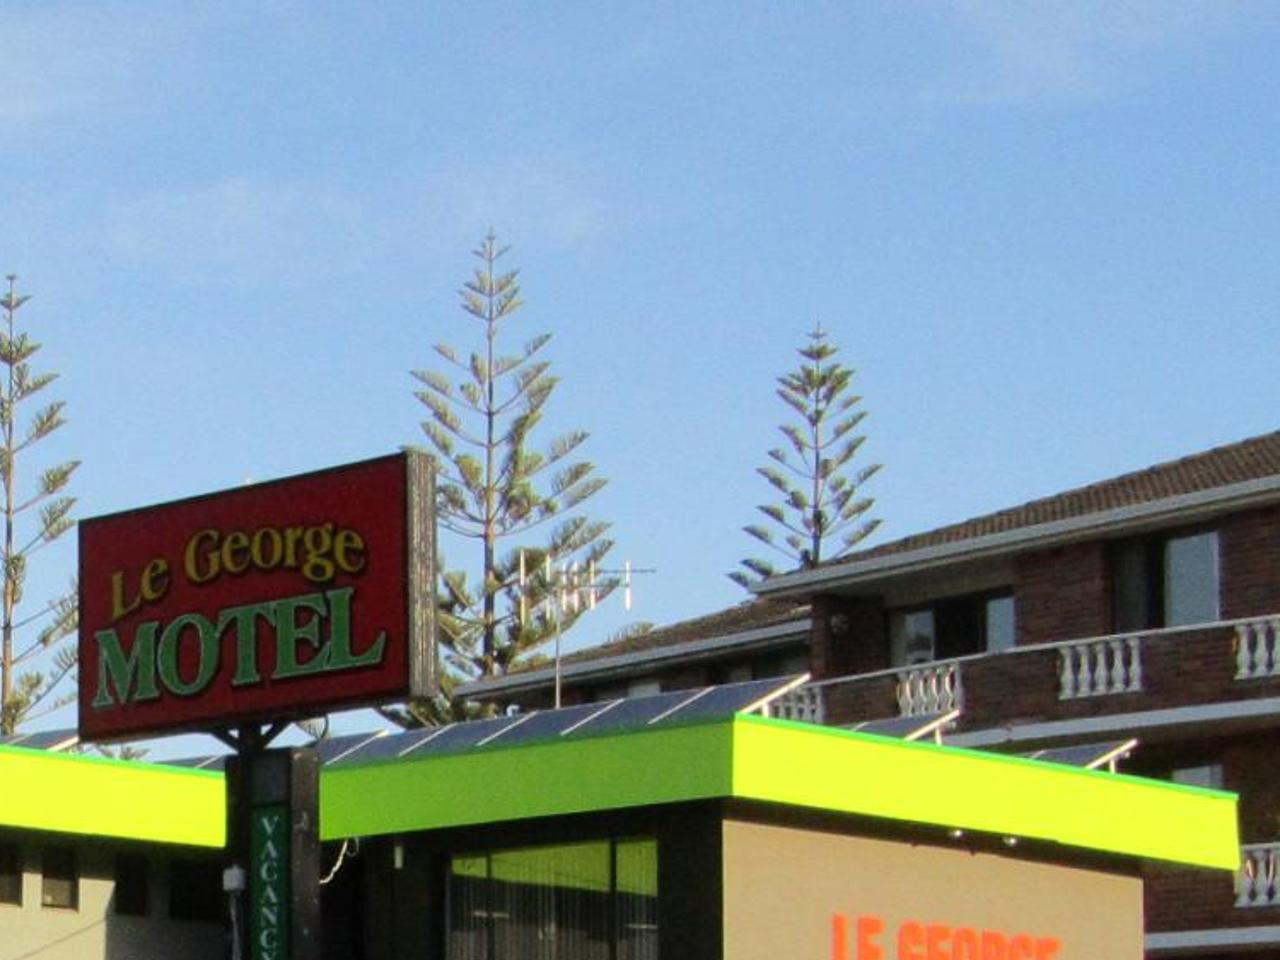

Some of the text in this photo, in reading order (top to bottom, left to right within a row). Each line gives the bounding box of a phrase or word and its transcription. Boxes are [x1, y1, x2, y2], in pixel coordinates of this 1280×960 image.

[111, 522, 365, 620] Le George
[92, 587, 387, 708] MOTEL
